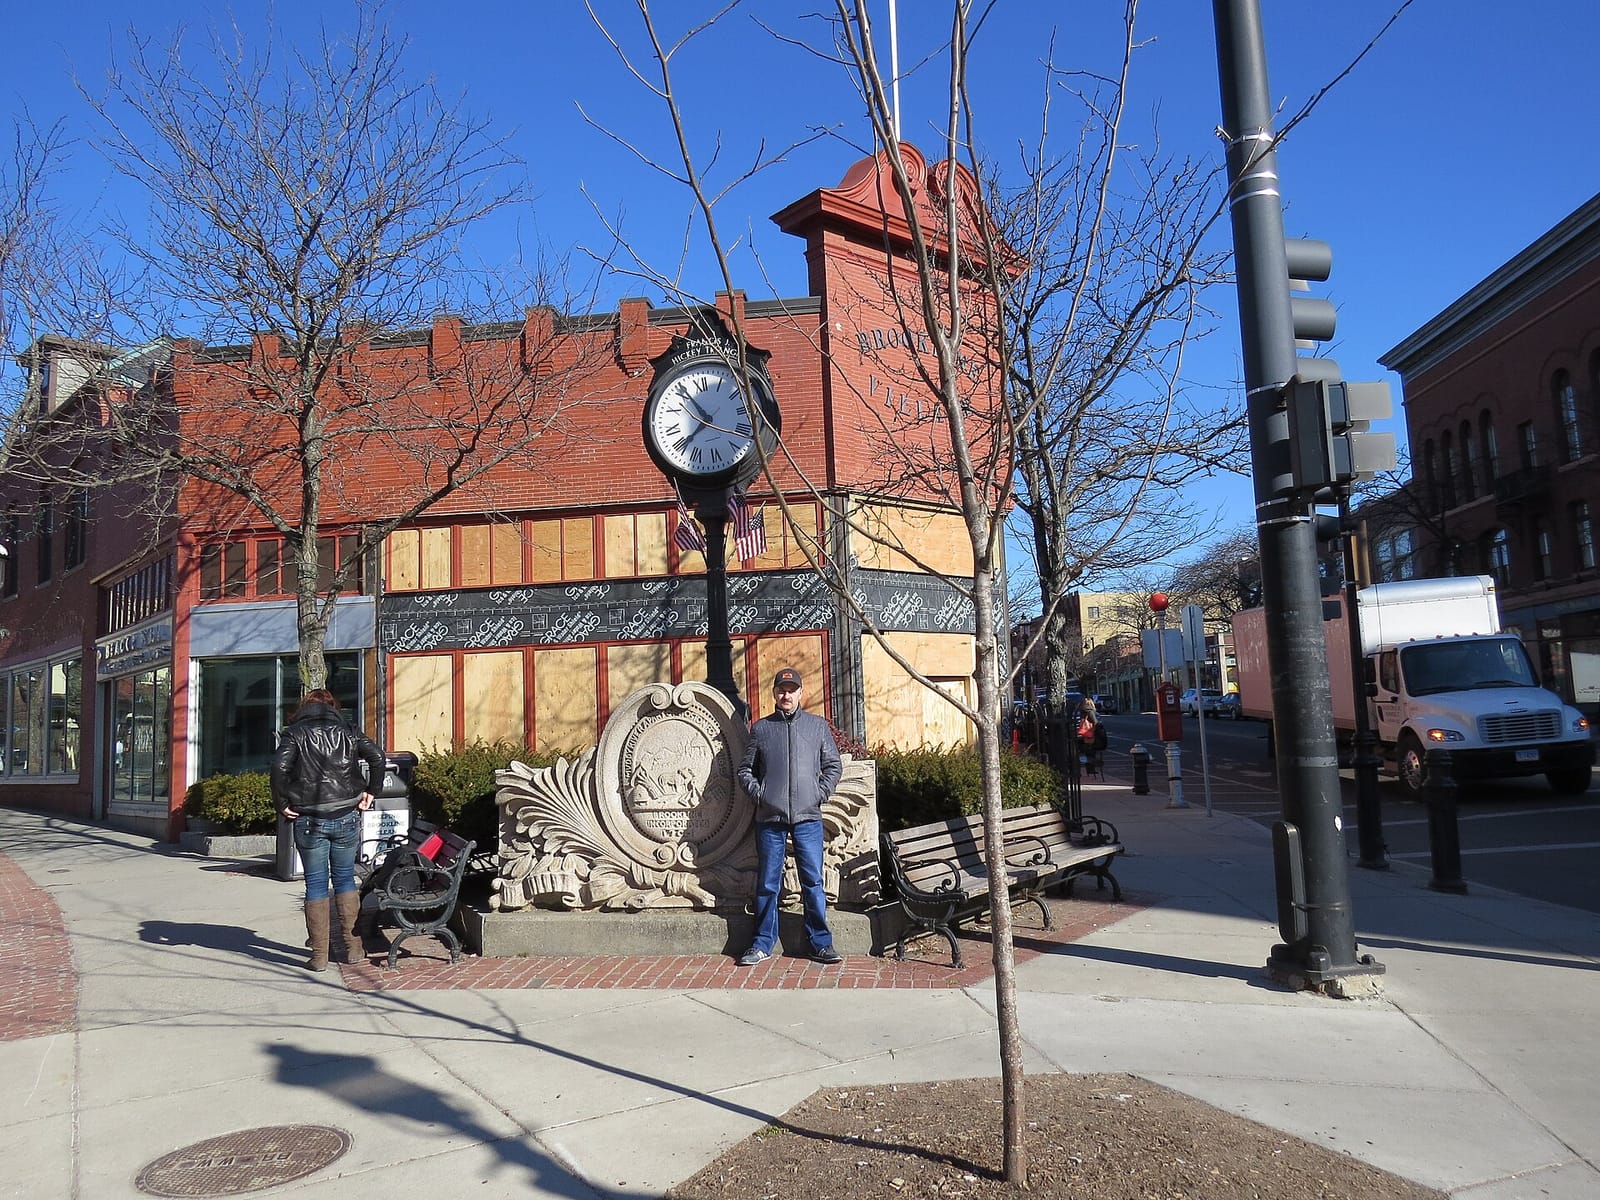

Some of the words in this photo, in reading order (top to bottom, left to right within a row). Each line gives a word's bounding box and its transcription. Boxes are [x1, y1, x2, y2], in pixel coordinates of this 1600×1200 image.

[672, 348, 701, 364] HICKEY
[706, 346, 738, 357] TRANG
[856, 328, 980, 380] BROOKNE
[574, 616, 600, 642] GRAC
[652, 611, 678, 638] GRAC
[730, 606, 758, 633] GRAC
[423, 625, 449, 650] GRAC
[498, 620, 524, 646] GRAC
